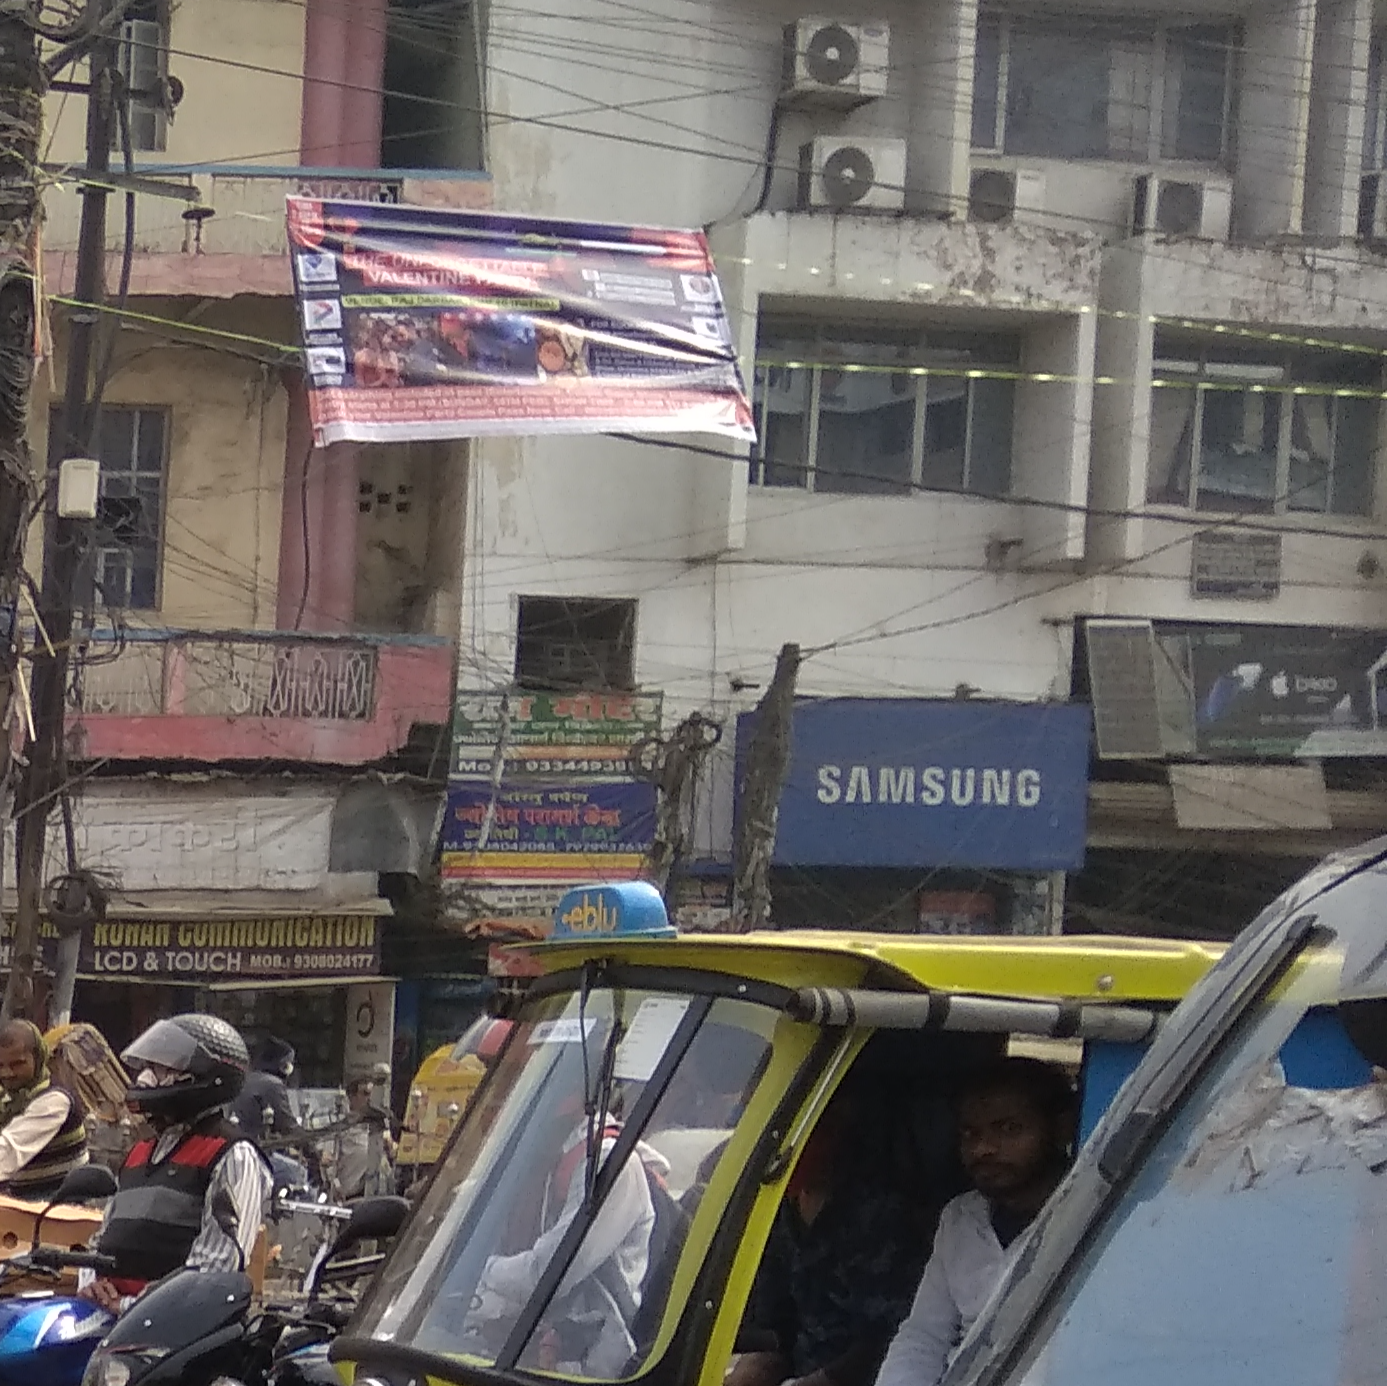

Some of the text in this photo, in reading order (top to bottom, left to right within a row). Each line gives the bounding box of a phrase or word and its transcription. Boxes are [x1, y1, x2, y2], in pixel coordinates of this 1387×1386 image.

[817, 764, 1042, 807] SAMSUNG
[94, 951, 138, 972] LCD
[143, 951, 159, 972] &
[165, 951, 242, 973] TOUCH
